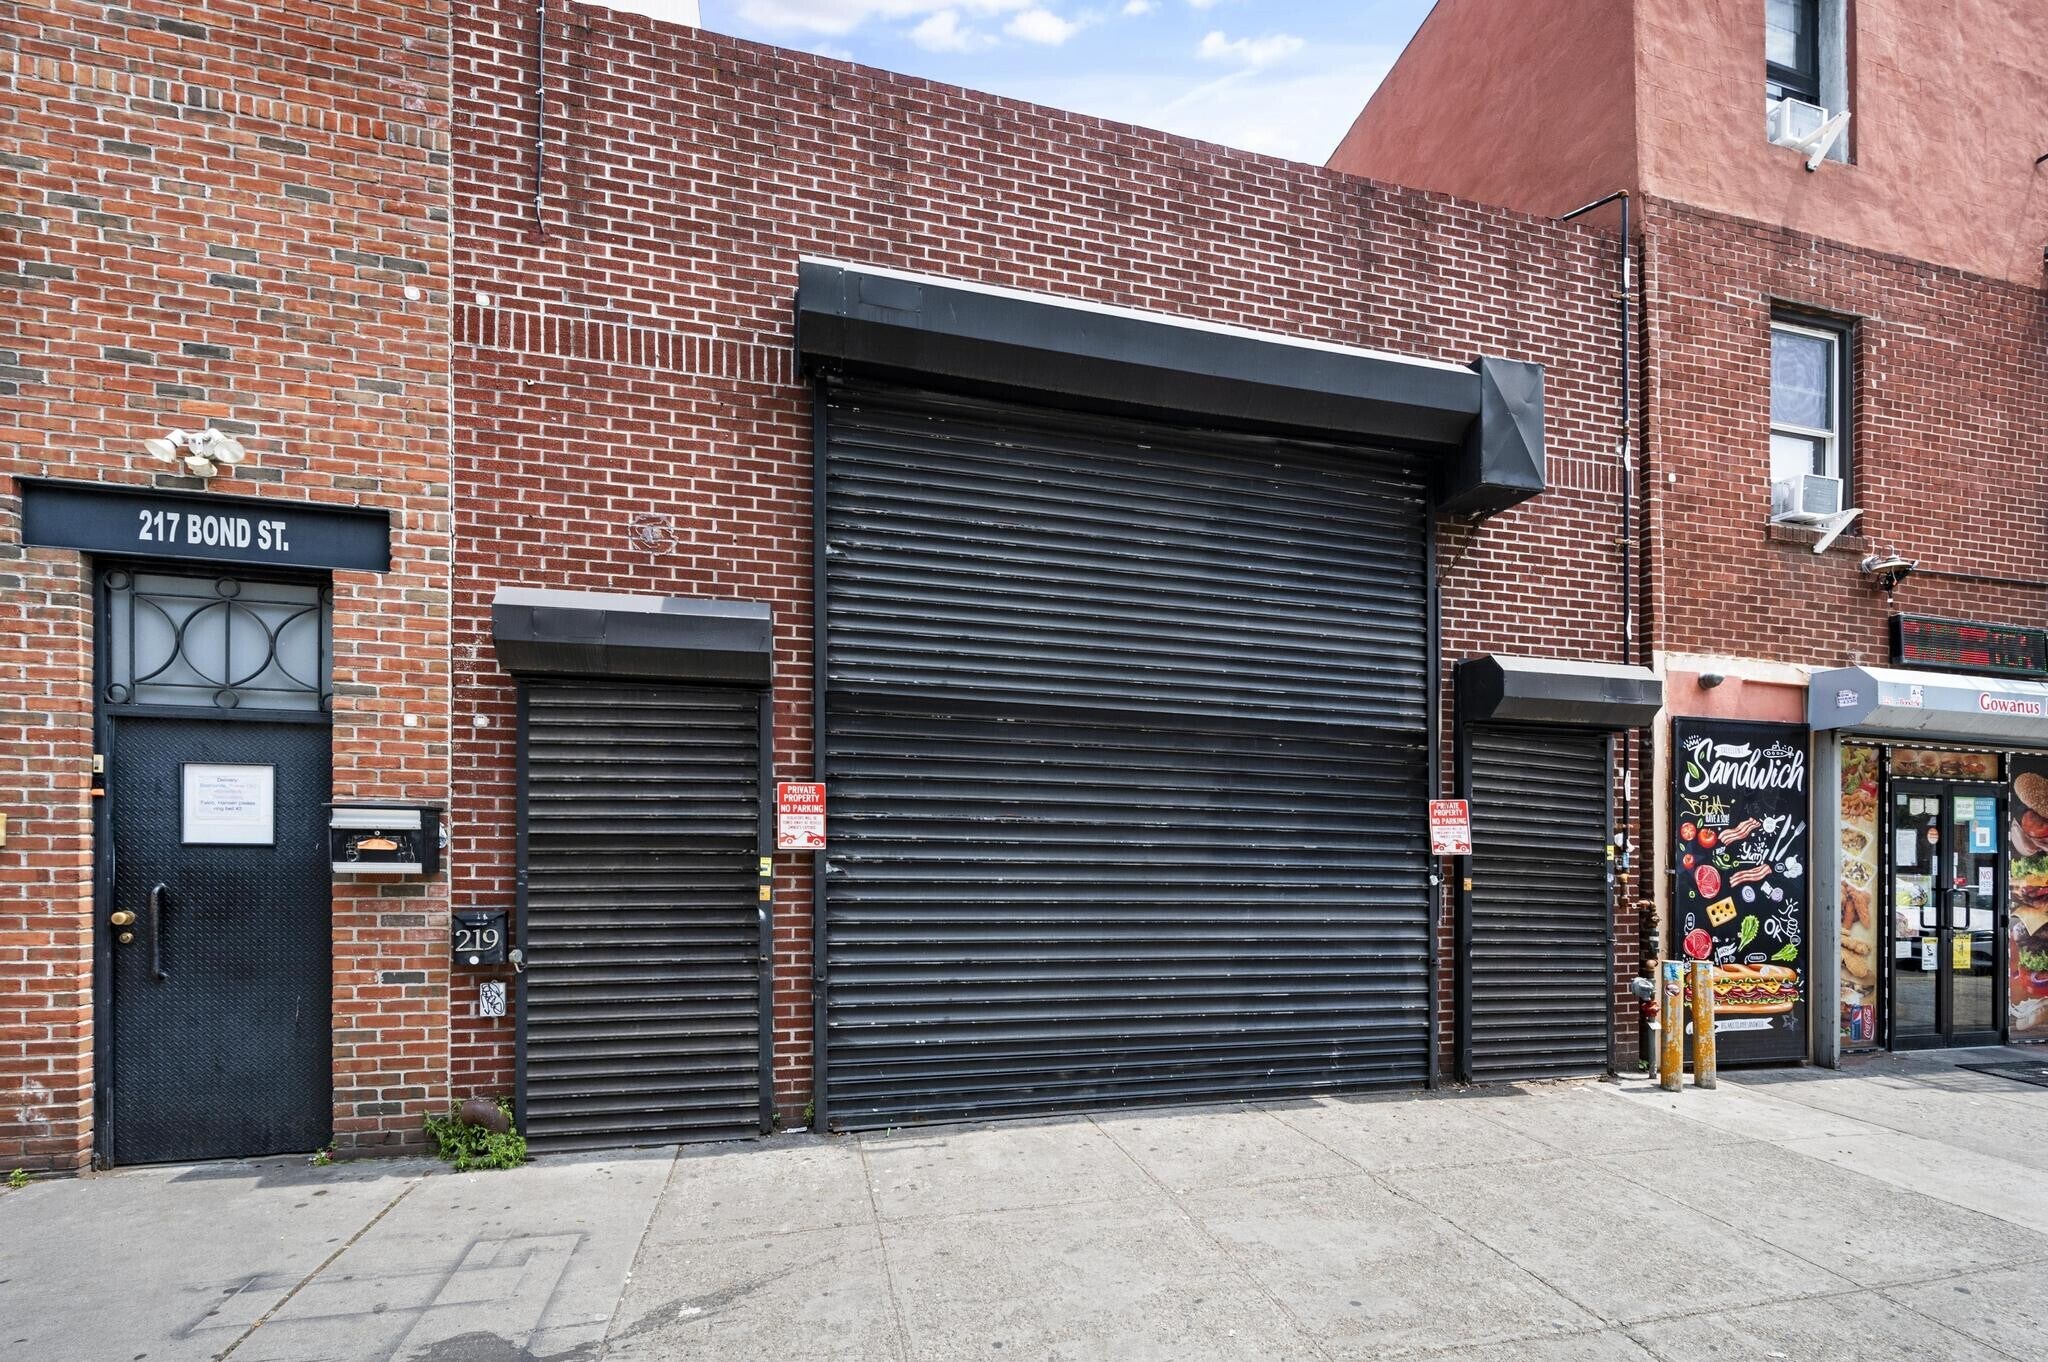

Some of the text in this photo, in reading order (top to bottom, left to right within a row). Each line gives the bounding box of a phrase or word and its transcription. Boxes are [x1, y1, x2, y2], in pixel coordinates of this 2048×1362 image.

[139, 510, 289, 551] 217 BOND ST.
[1980, 693, 2041, 715] Gowanus
[1684, 738, 1804, 793] Sandwich
[788, 786, 816, 794] PRIVATE
[784, 794, 819, 802] PROPERTY
[793, 805, 823, 813] PARKING
[1433, 809, 1463, 817] PROPERTY
[1436, 802, 1459, 810] PRIVATE
[1764, 918, 1783, 943] OK
[455, 929, 499, 952] 219
